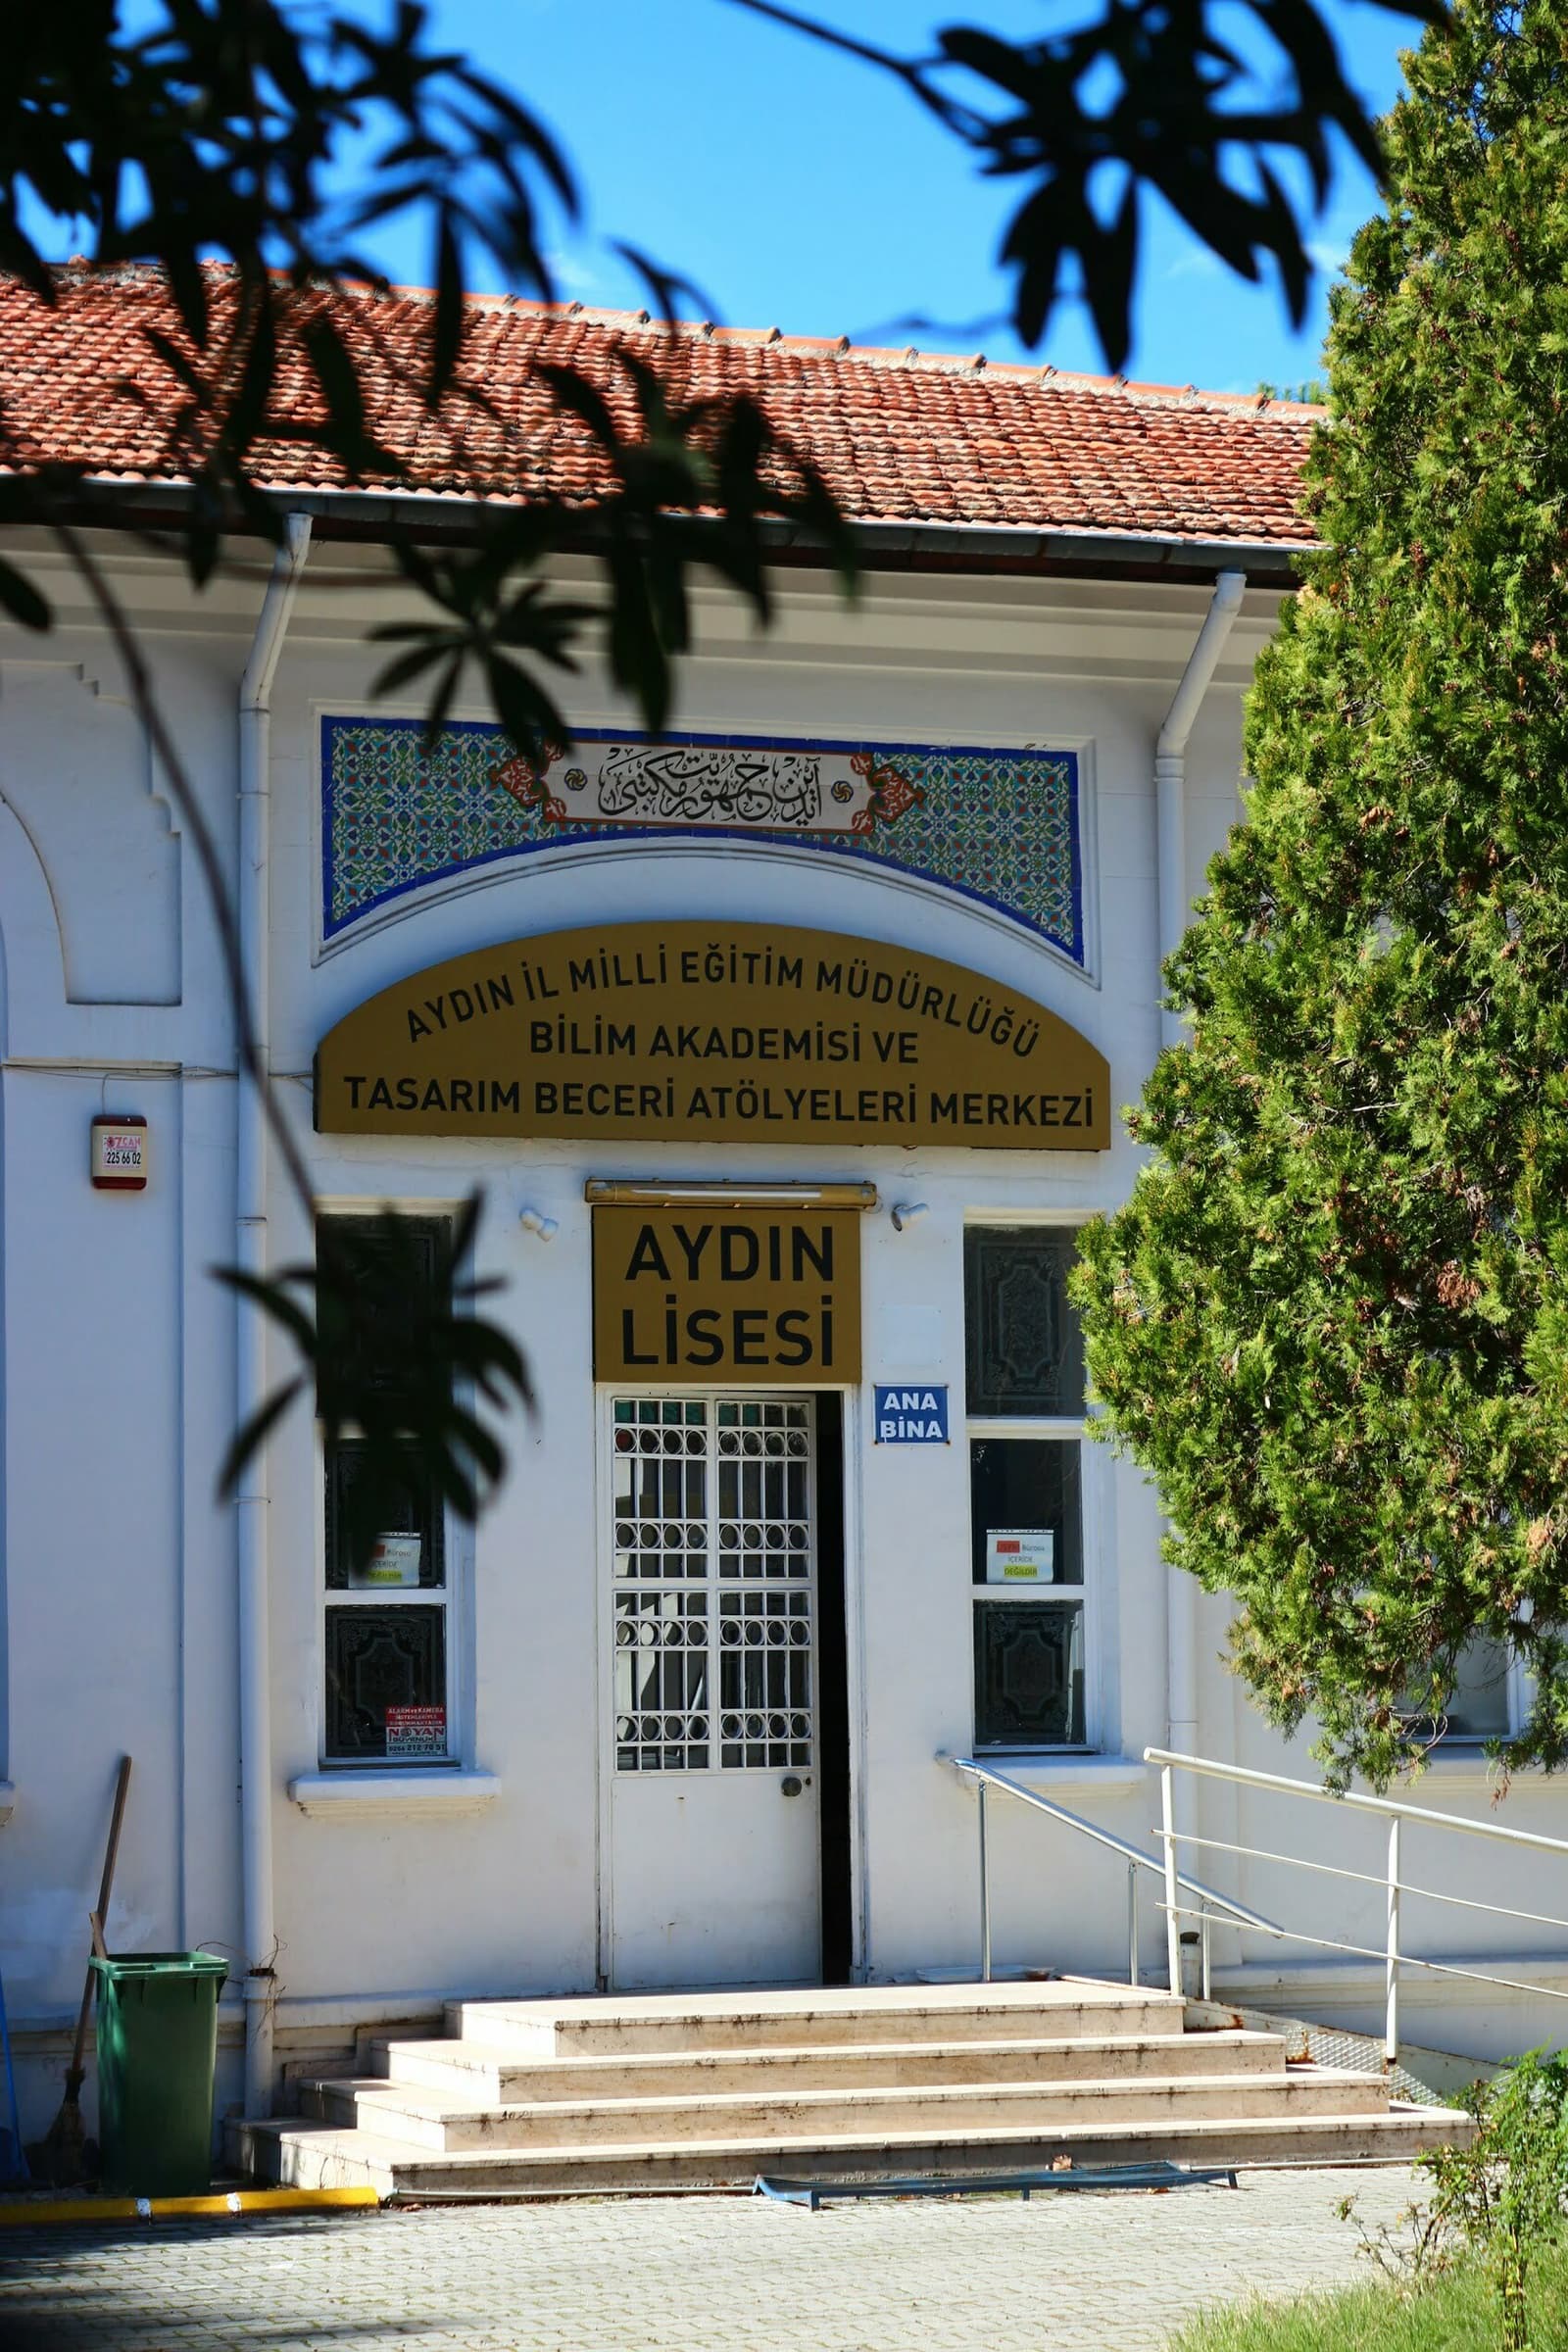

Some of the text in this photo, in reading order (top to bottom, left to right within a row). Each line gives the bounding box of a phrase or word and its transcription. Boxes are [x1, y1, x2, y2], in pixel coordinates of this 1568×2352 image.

[406, 942, 1040, 1057] AYDIN İL MİLLİ EĞİTİM MÜDÜRLÜĞÜ
[530, 1013, 918, 1063] BİLİM AKADEMİSİ VE
[343, 1076, 1094, 1127] TASARIM BECERİ ATÖLYELERİ MERKEZİ
[107, 1152, 120, 1164] 225
[122, 1152, 130, 1164] 66
[132, 1152, 141, 1164] 02
[625, 1225, 833, 1281] AYDIN
[622, 1294, 833, 1366] LİSESİ
[884, 1392, 938, 1410] ANA
[880, 1416, 943, 1439] BİNA
[1004, 1566, 1037, 1576] DEĞİLDİR
[389, 1728, 444, 1741] NOYAN
